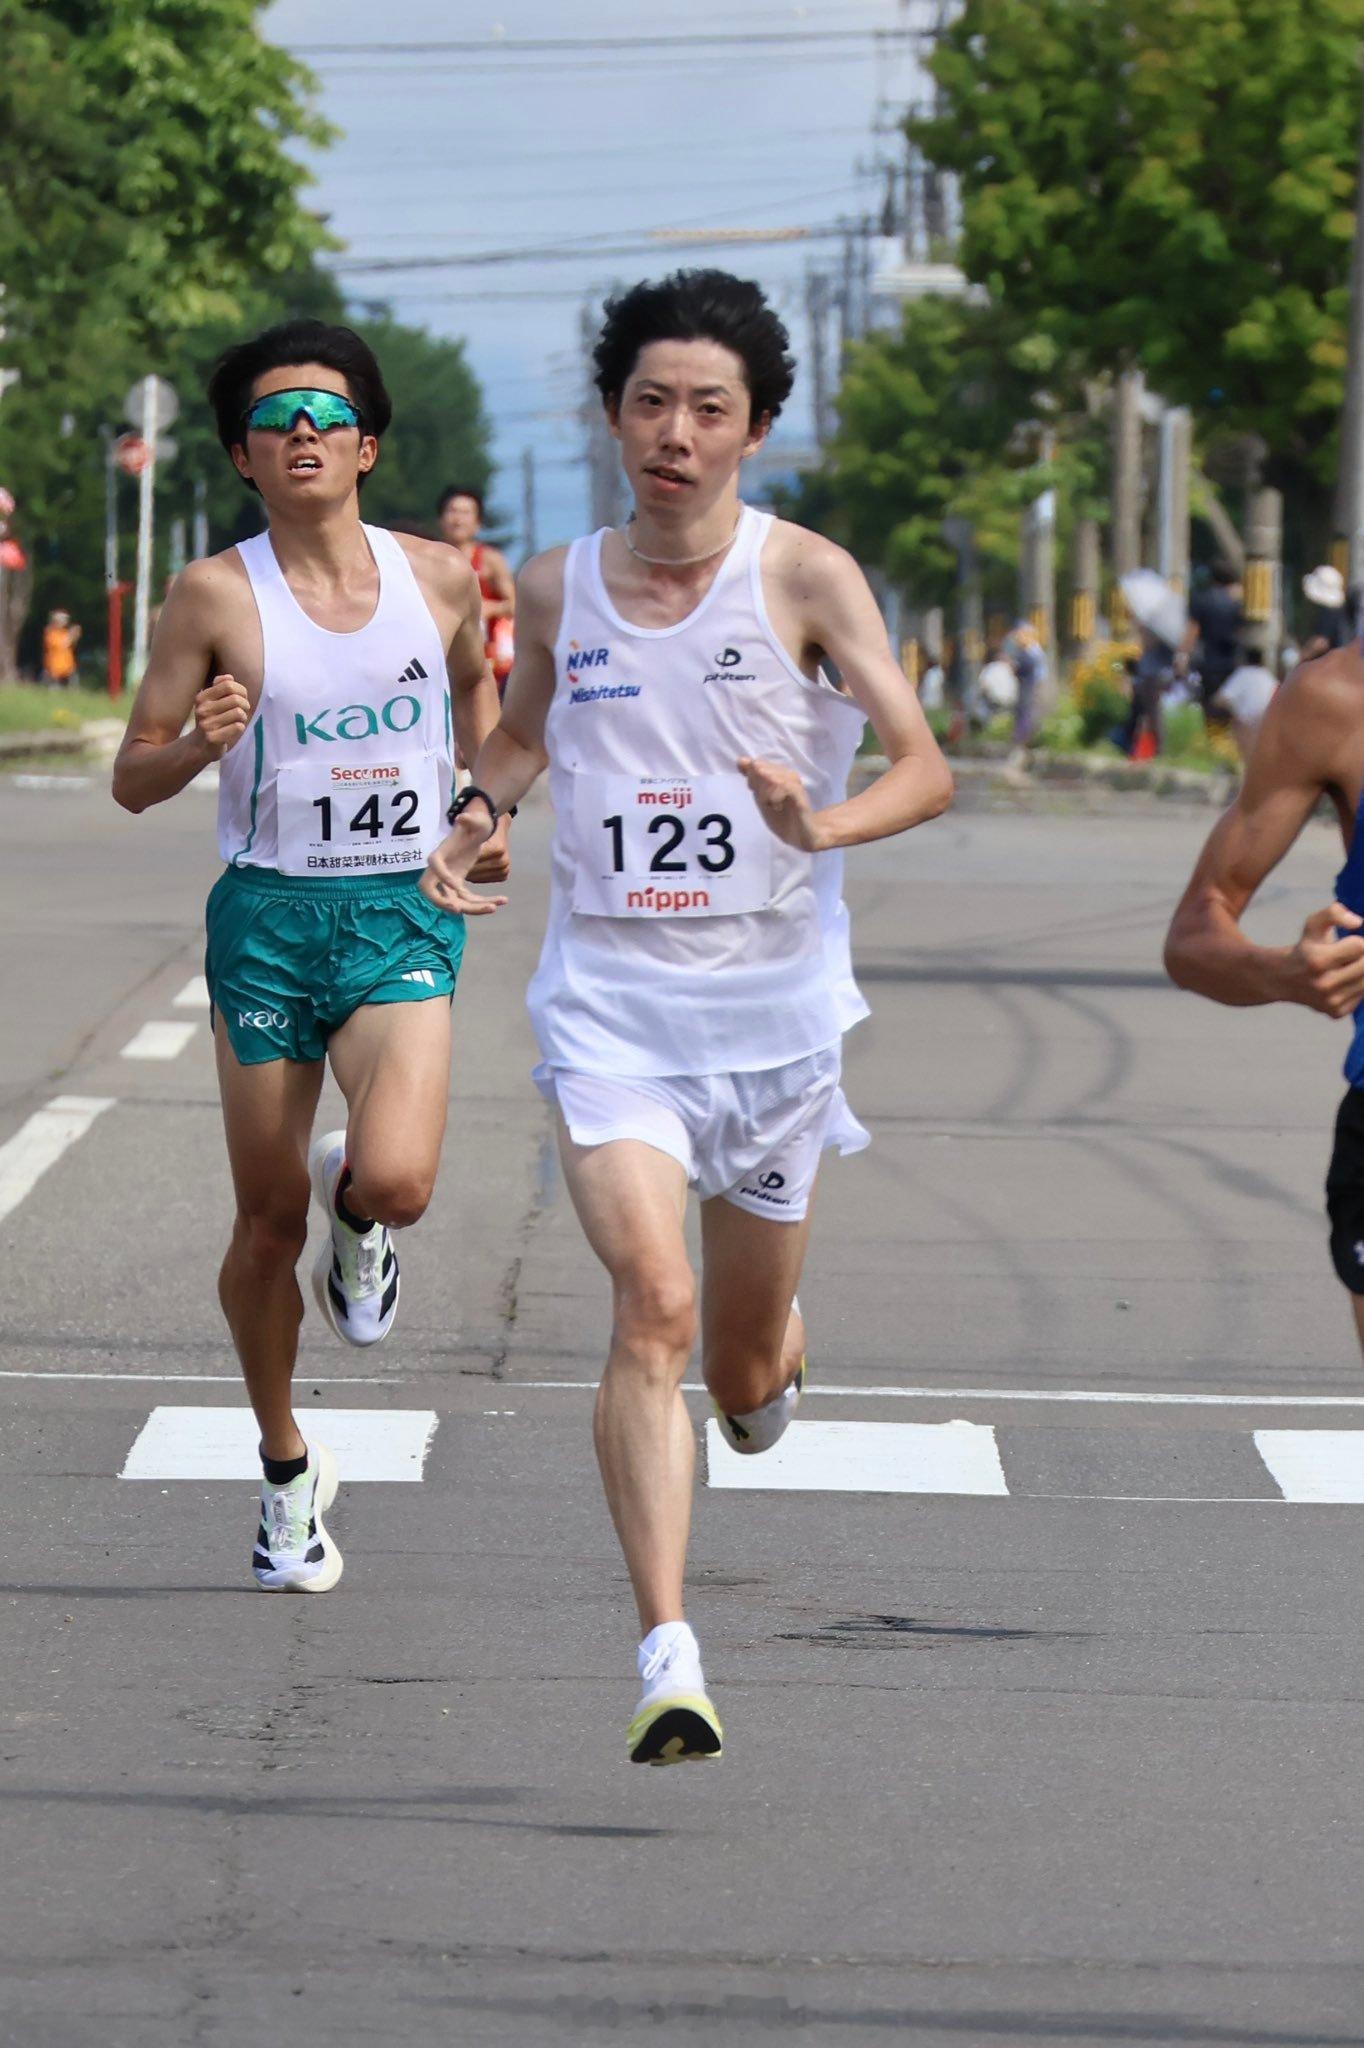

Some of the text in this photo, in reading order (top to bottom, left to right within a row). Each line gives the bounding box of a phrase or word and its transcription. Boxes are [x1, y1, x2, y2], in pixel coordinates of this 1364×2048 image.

[567, 649, 609, 671] NNR
[569, 684, 641, 704] Nishitetsu
[331, 767, 400, 780] Secoma
[637, 787, 692, 808] meiji
[313, 789, 421, 841] 142
[602, 814, 735, 872] 123
[307, 848, 423, 869] 日本甜菜製糖株式会社
[627, 886, 710, 911] nippn
